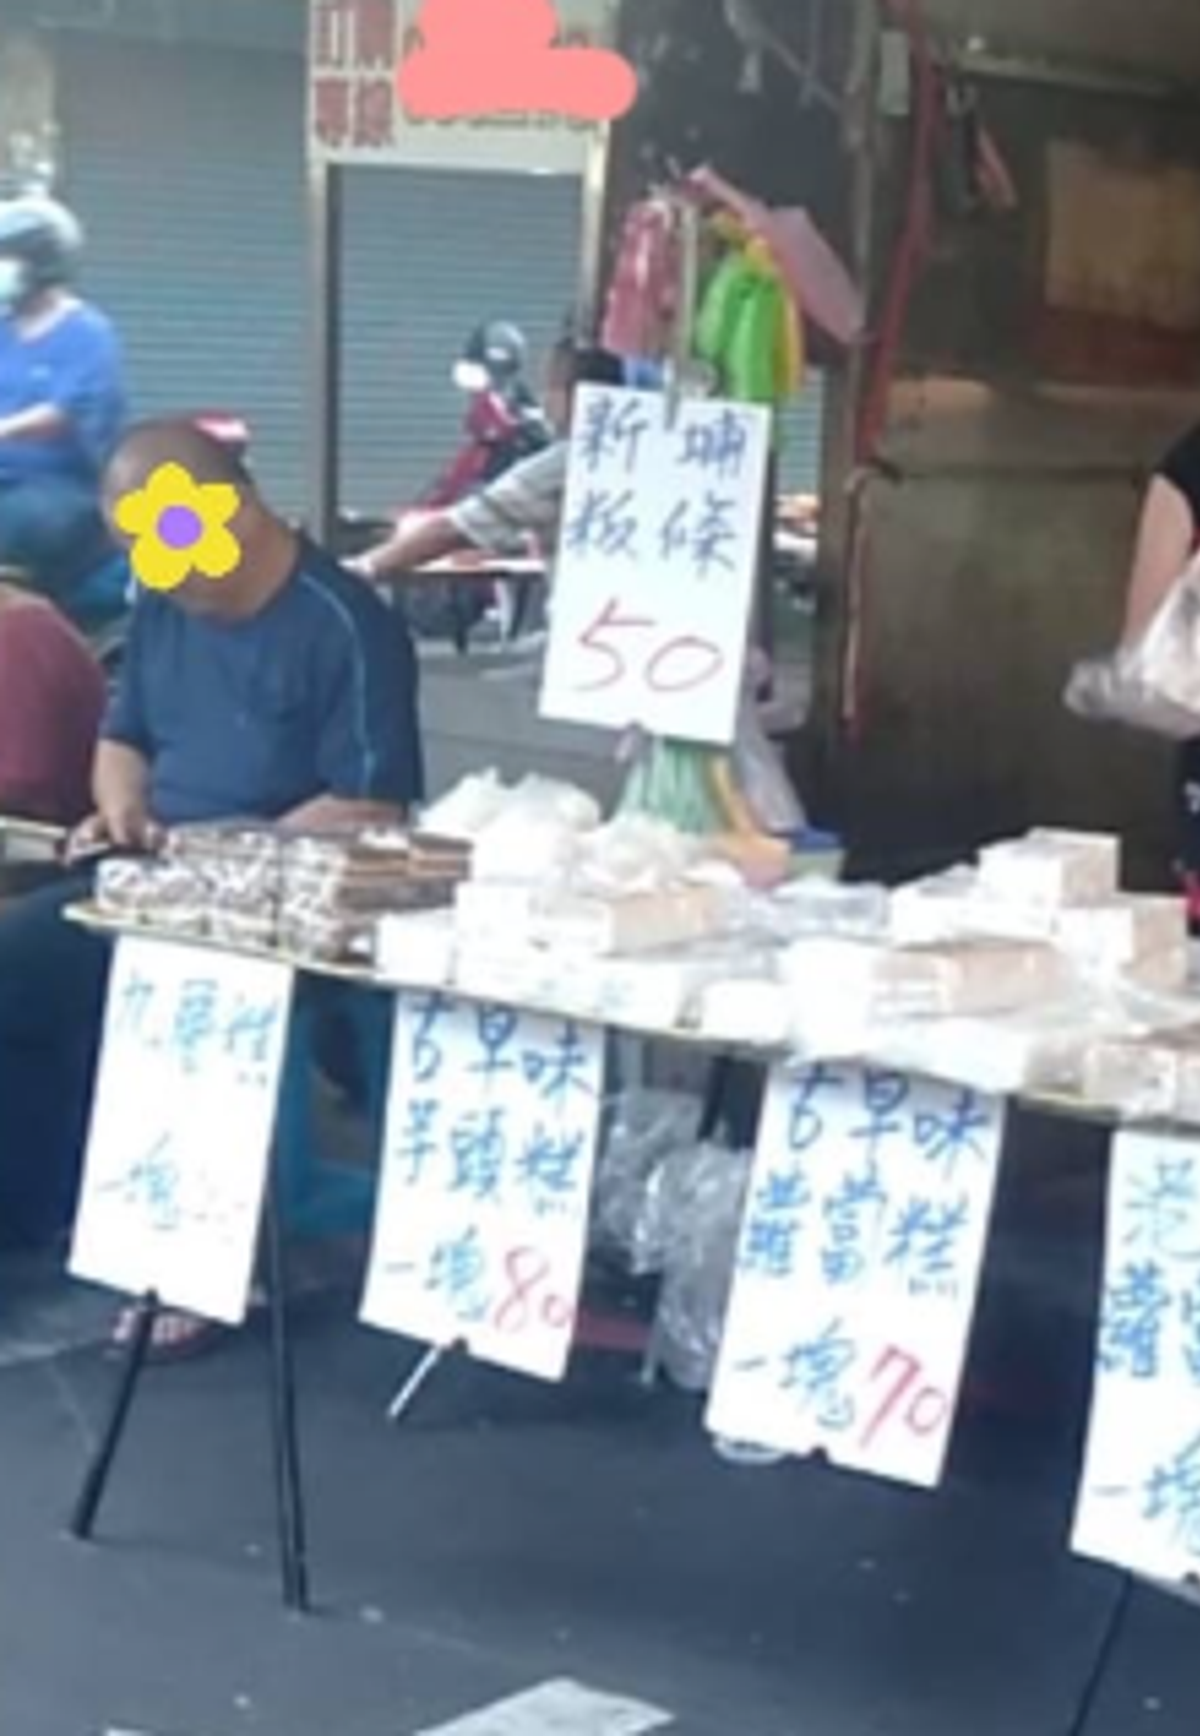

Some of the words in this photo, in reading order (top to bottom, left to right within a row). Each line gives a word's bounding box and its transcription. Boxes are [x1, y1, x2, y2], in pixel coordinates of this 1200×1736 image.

[573, 598, 725, 692] 50
[787, 1062, 990, 1182] 古早味
